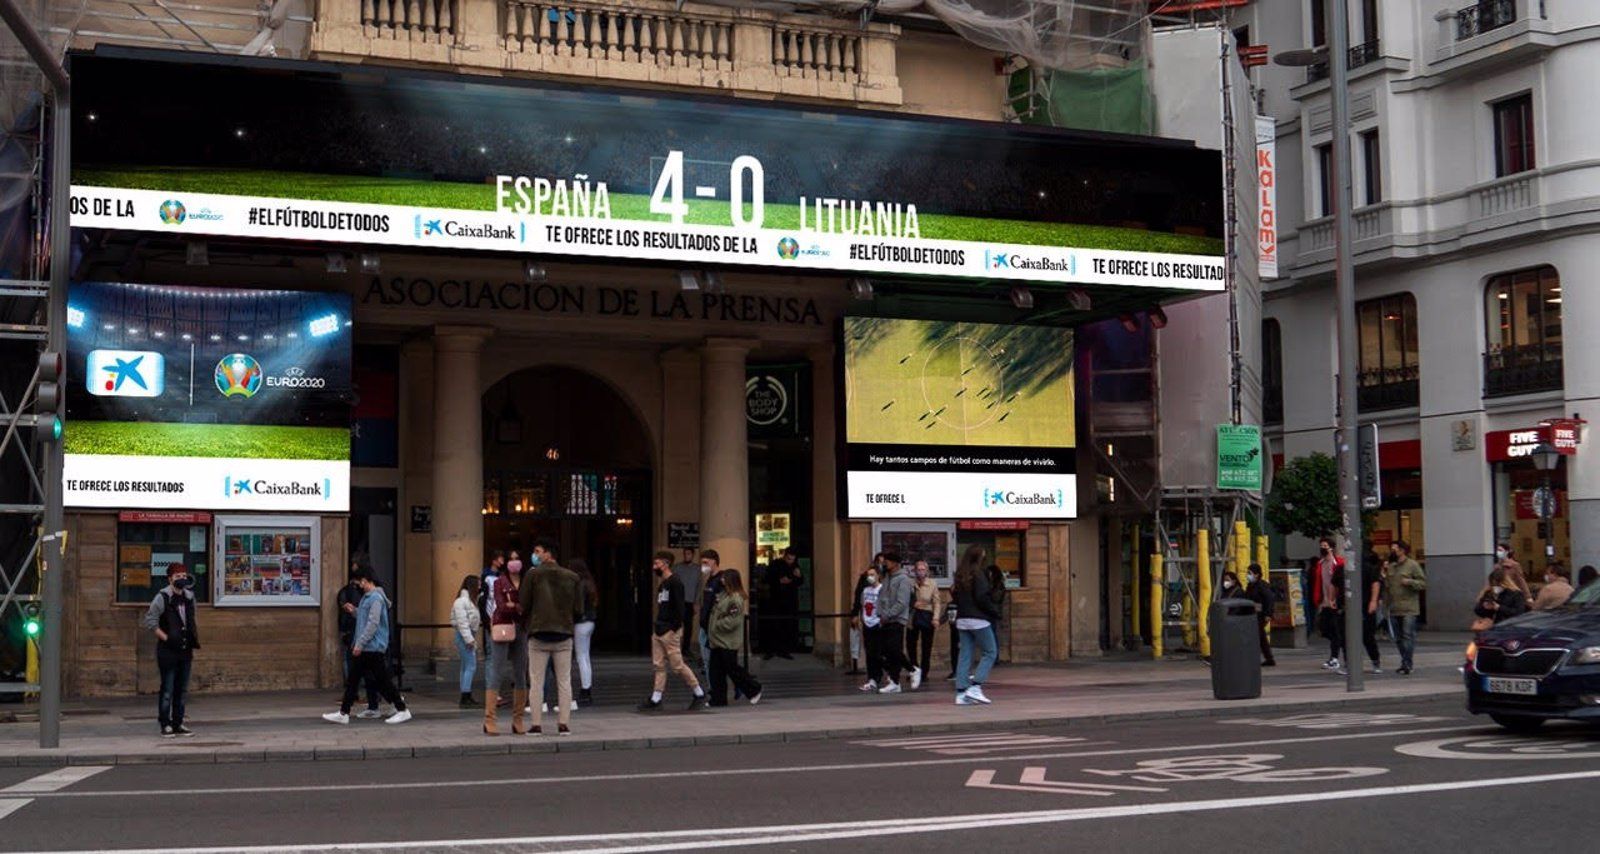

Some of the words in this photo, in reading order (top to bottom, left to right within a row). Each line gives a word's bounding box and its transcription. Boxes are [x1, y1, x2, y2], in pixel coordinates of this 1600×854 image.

[70, 196, 88, 215] OS
[94, 198, 111, 216] DE
[117, 199, 134, 217] LA
[496, 174, 613, 220] ESPAÑA
[799, 196, 921, 239] LITUANIA
[249, 206, 390, 232] #ELFÚTBOLDETODOS
[445, 220, 516, 239] CaixaBank
[546, 225, 561, 242] TE
[565, 226, 613, 245] OFRECE
[617, 229, 639, 247] LOS
[643, 231, 720, 252] RESULTADOS
[723, 236, 739, 253] DE
[743, 237, 758, 254] LA
[850, 243, 965, 267] #ELFÚTBOLDETODOS
[1010, 255, 1069, 272] CaixaBank
[1093, 259, 1105, 275] TE
[1109, 260, 1149, 277] OFRECE
[1152, 262, 1171, 278] LOS
[1174, 263, 1224, 281] RESULTAD
[363, 278, 585, 313] ASOCIACION
[599, 288, 640, 316] DE
[651, 290, 695, 319] LA
[701, 293, 824, 326] PRENSA
[266, 376, 326, 389] EURO2020
[755, 390, 770, 398] THE
[749, 398, 778, 407] BODY
[1509, 431, 1539, 444] FIVE
[1555, 429, 1575, 438] FIVE
[1555, 438, 1577, 447] GUYS
[546, 448, 560, 460] 46
[869, 455, 884, 465] Hay
[885, 456, 909, 464] tantos
[910, 457, 937, 466] campos
[938, 456, 947, 464] de
[949, 456, 971, 465] fútbol
[1022, 458, 1032, 466] de
[67, 480, 77, 491] TE
[79, 480, 112, 492] OFRECE
[113, 481, 130, 492] LOS
[131, 481, 185, 493] RESULTADOS
[254, 481, 321, 495] CaixaBank
[866, 493, 874, 503] TE
[875, 494, 900, 503] OFRECE
[1005, 491, 1056, 504] CaixaBank
